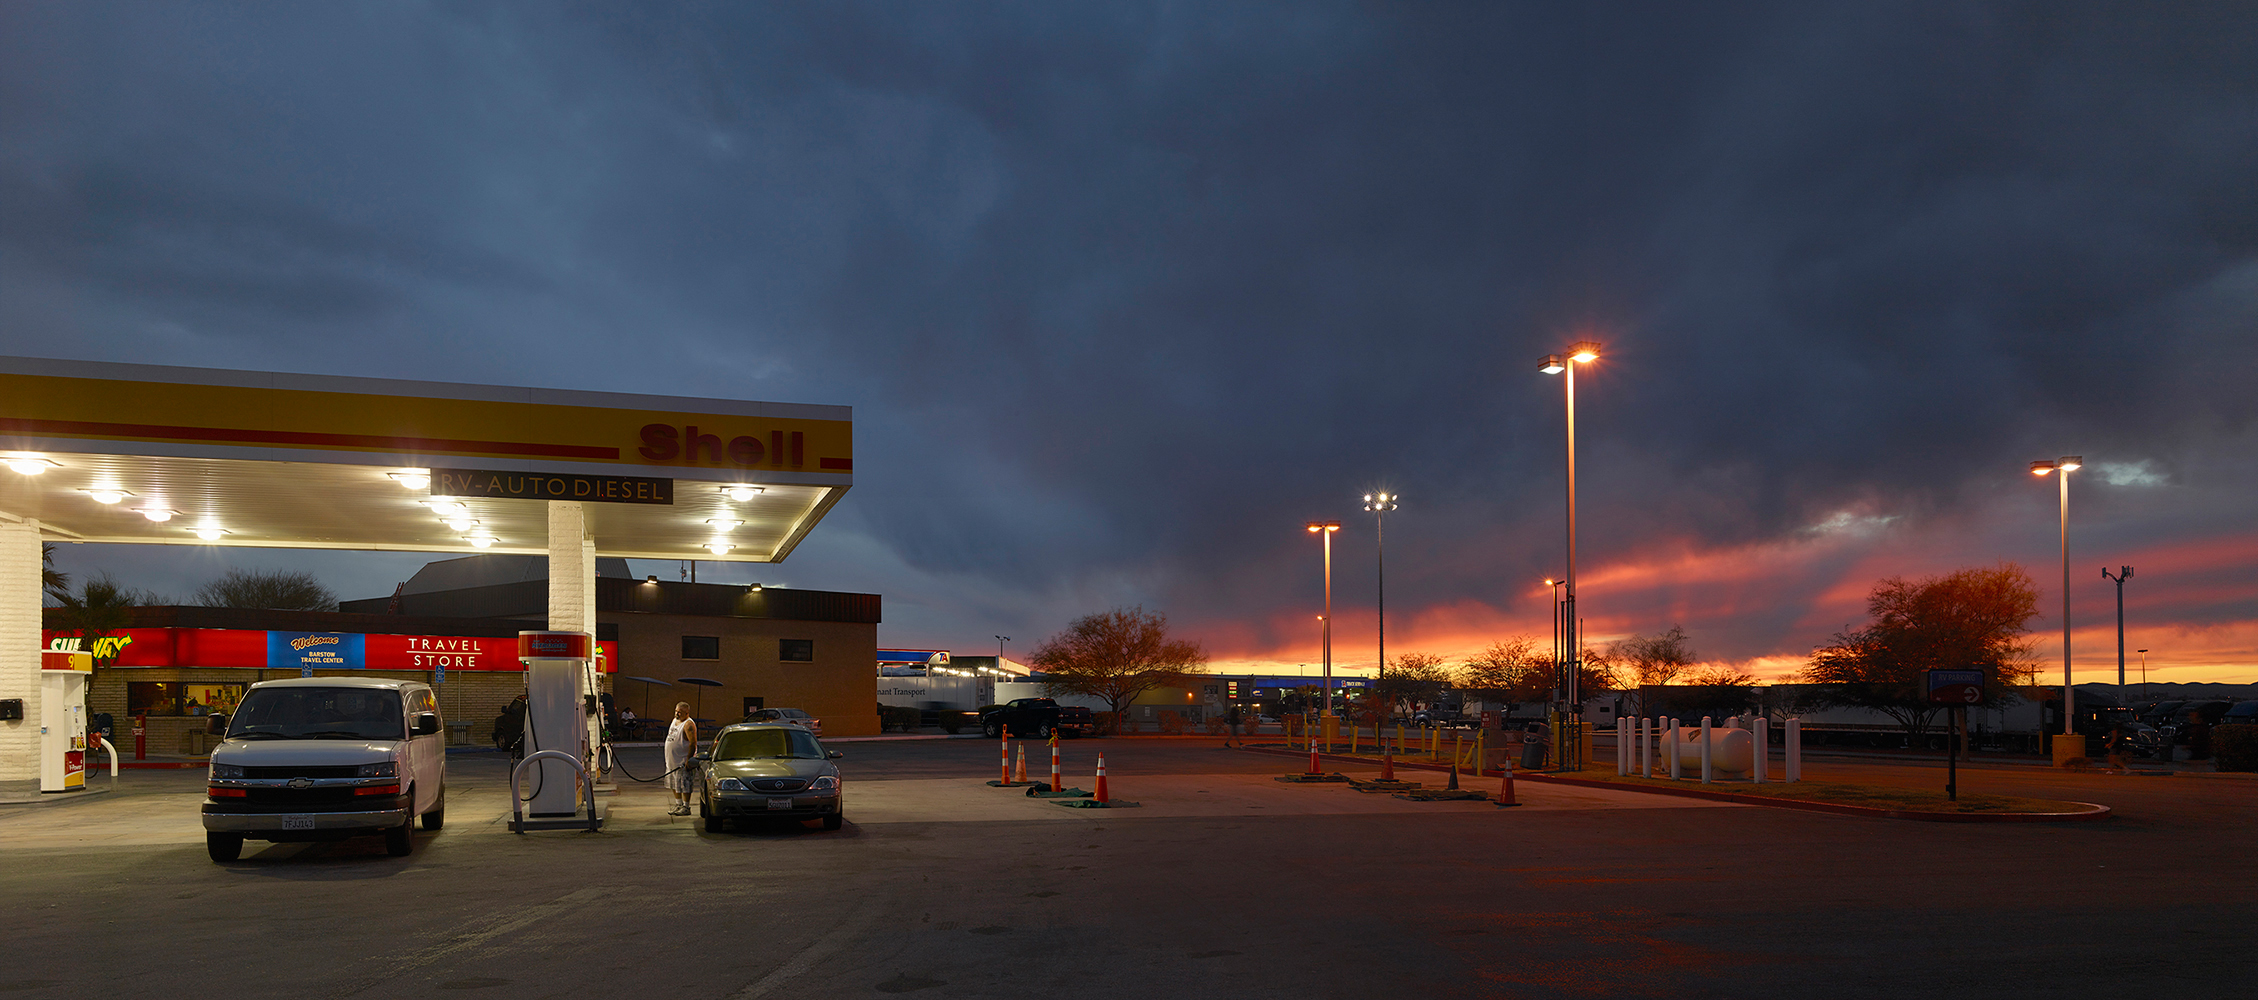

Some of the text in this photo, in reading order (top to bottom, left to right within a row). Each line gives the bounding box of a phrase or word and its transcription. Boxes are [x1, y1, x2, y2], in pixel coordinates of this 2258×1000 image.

[638, 423, 804, 466] Shell
[441, 473, 664, 500] RV-AUTO DIESEL
[291, 635, 339, 650] Welcome
[408, 638, 481, 651] TRAVEL
[68, 655, 75, 668] 9
[414, 655, 475, 667] STORE
[939, 652, 948, 662] TA
[893, 688, 925, 697] Transport
[284, 820, 314, 828] 7FJJ143
